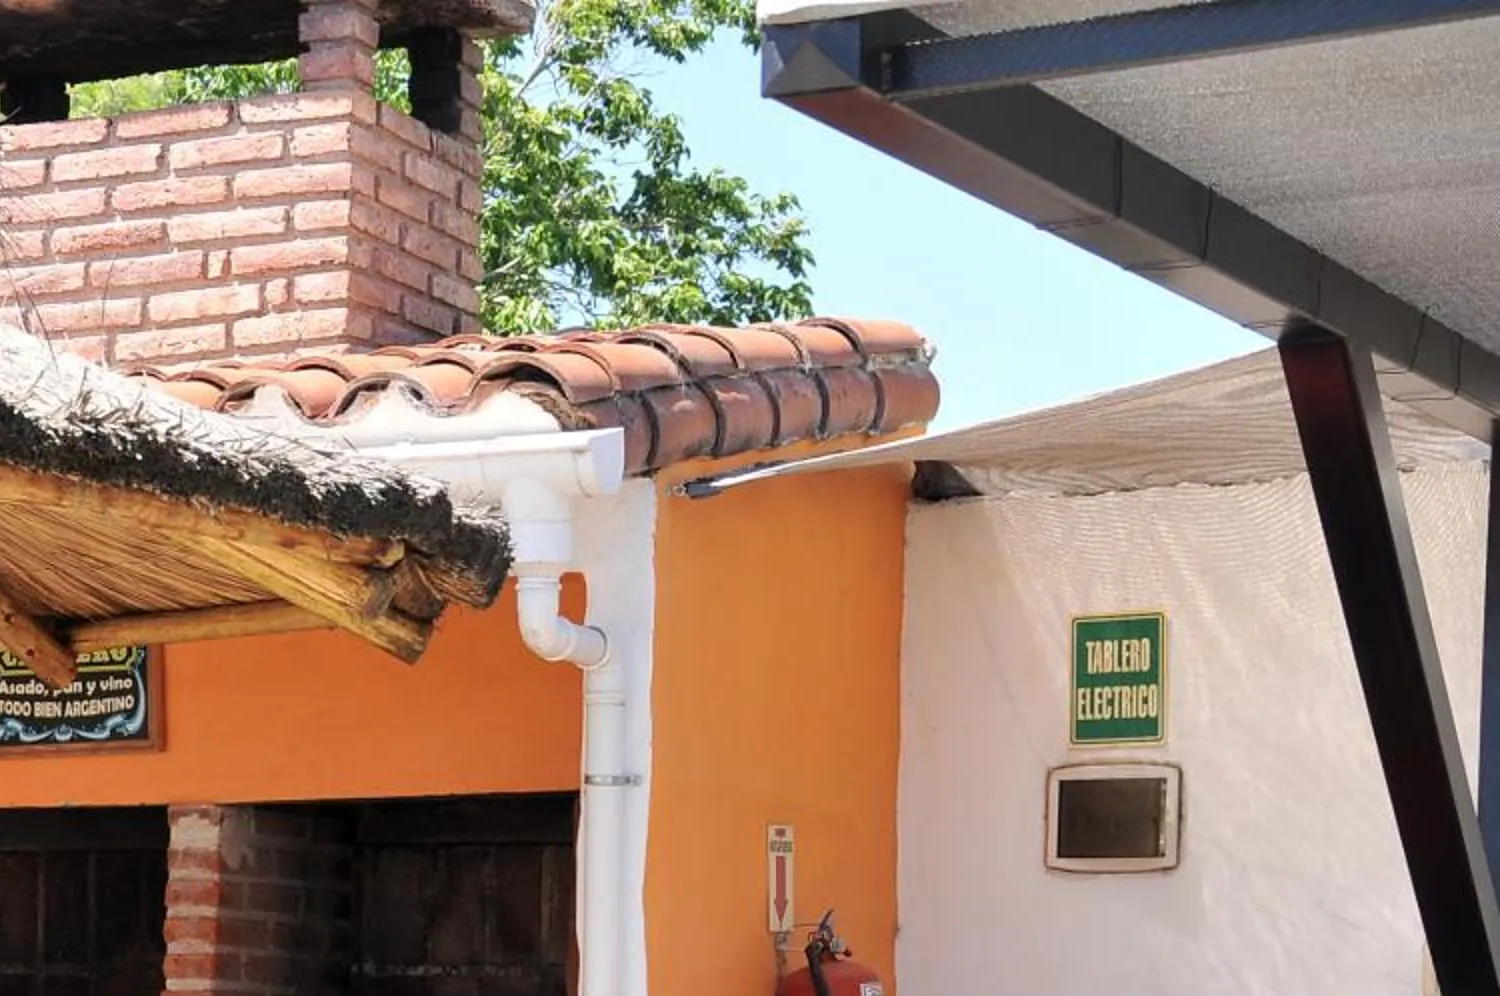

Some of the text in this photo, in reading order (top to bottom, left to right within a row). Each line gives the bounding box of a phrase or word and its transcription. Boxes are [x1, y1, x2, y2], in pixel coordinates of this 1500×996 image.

[1086, 638, 1151, 674] TABLERO
[87, 680, 97, 695] y
[100, 675, 133, 692] vino
[33, 701, 62, 718] BIEN
[64, 694, 135, 717] ARGENTINO
[1077, 684, 1158, 720] ELECTRICO
